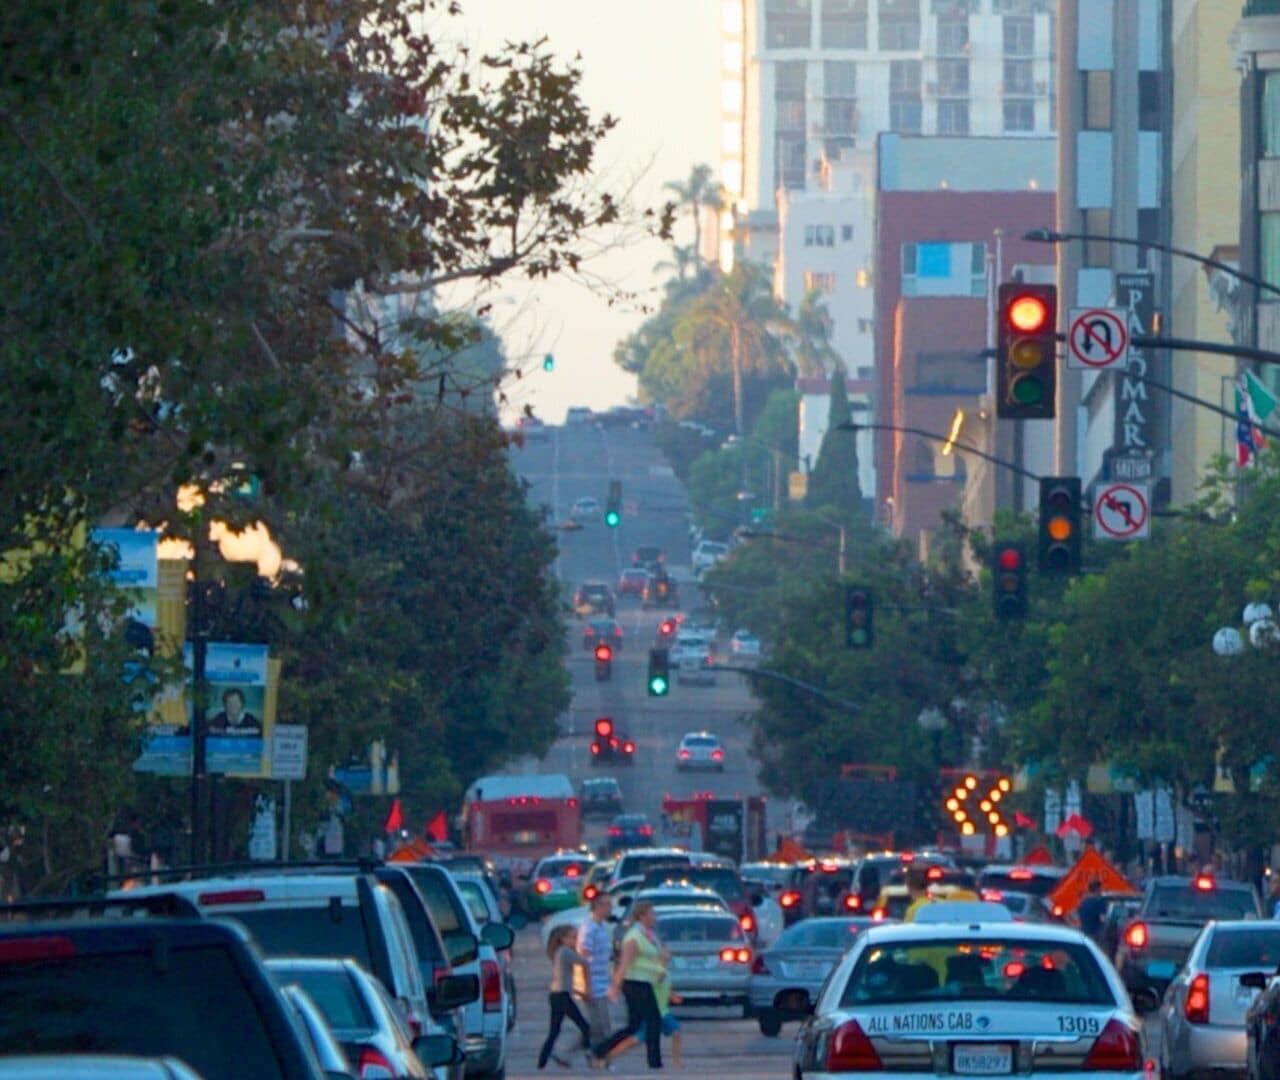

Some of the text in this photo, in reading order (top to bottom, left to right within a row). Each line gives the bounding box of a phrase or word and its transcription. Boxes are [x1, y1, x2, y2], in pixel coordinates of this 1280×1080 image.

[1120, 277, 1150, 287] HOTEL
[868, 1012, 973, 1033] ALL NATIONS CAB
[1056, 1016, 1100, 1034] 1309
